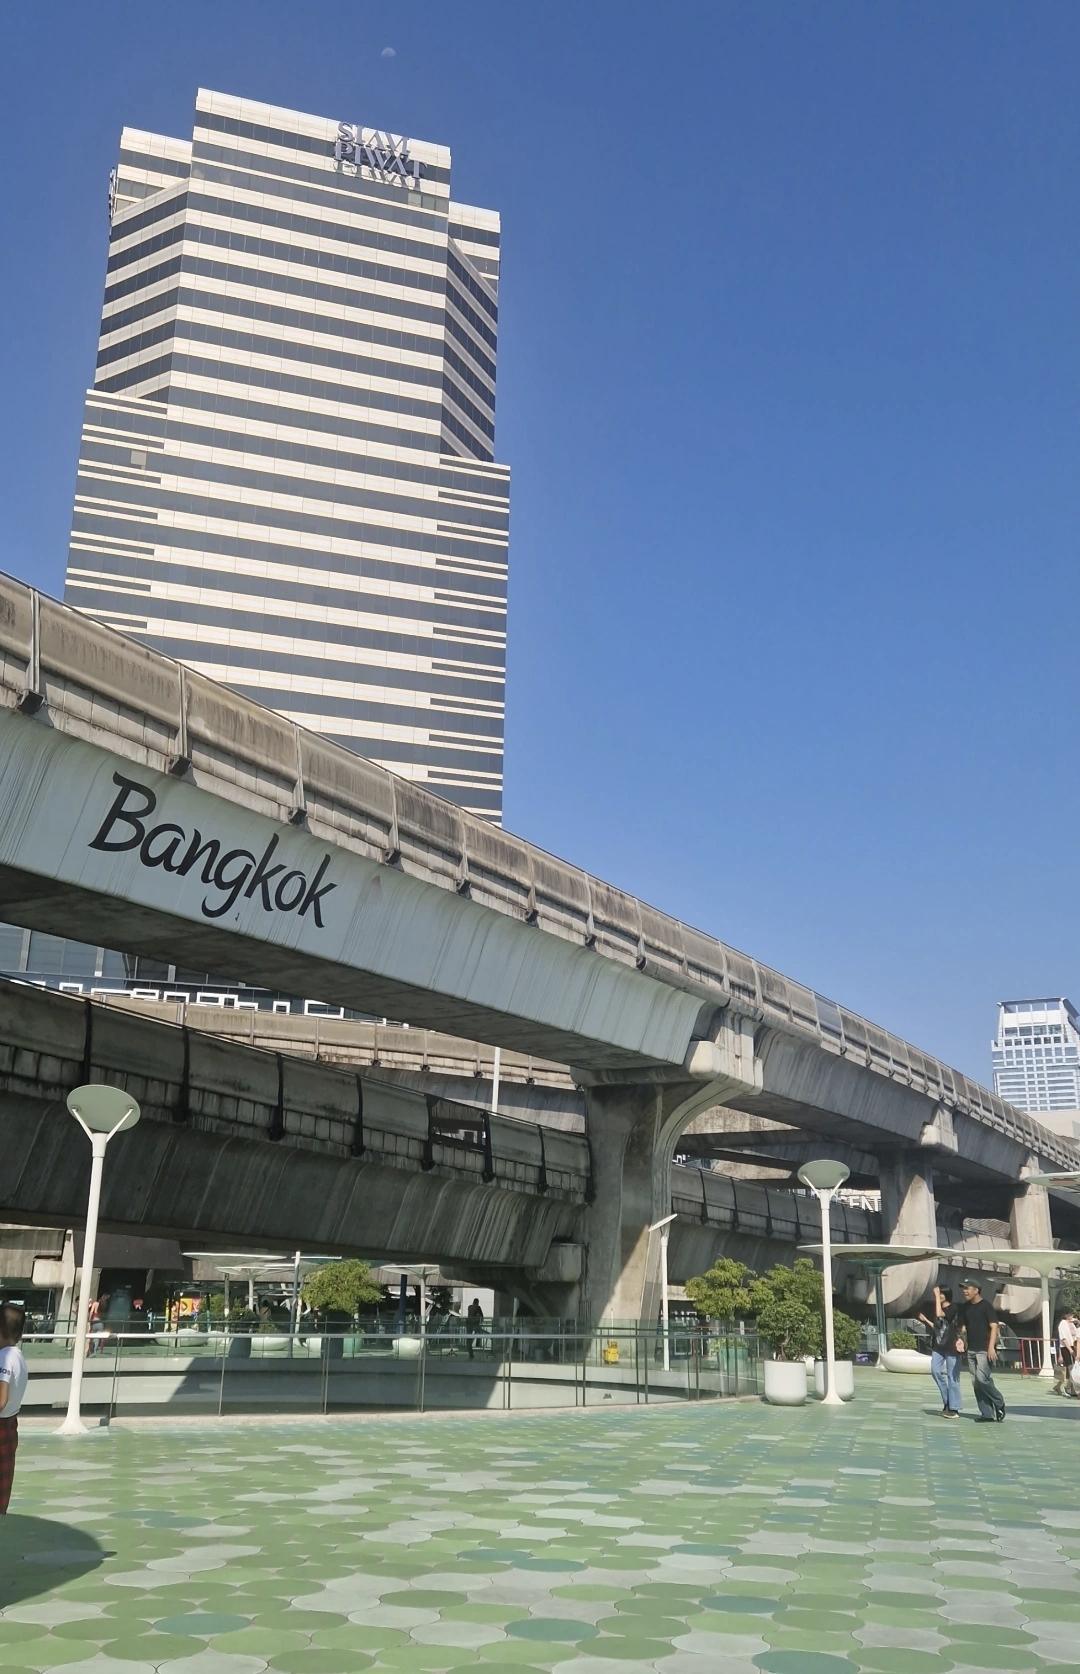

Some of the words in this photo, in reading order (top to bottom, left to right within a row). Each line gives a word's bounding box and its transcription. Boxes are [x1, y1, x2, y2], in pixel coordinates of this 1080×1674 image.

[337, 121, 411, 156] SIAM
[334, 140, 428, 179] PIWAT
[88, 771, 338, 928] Bangkok
